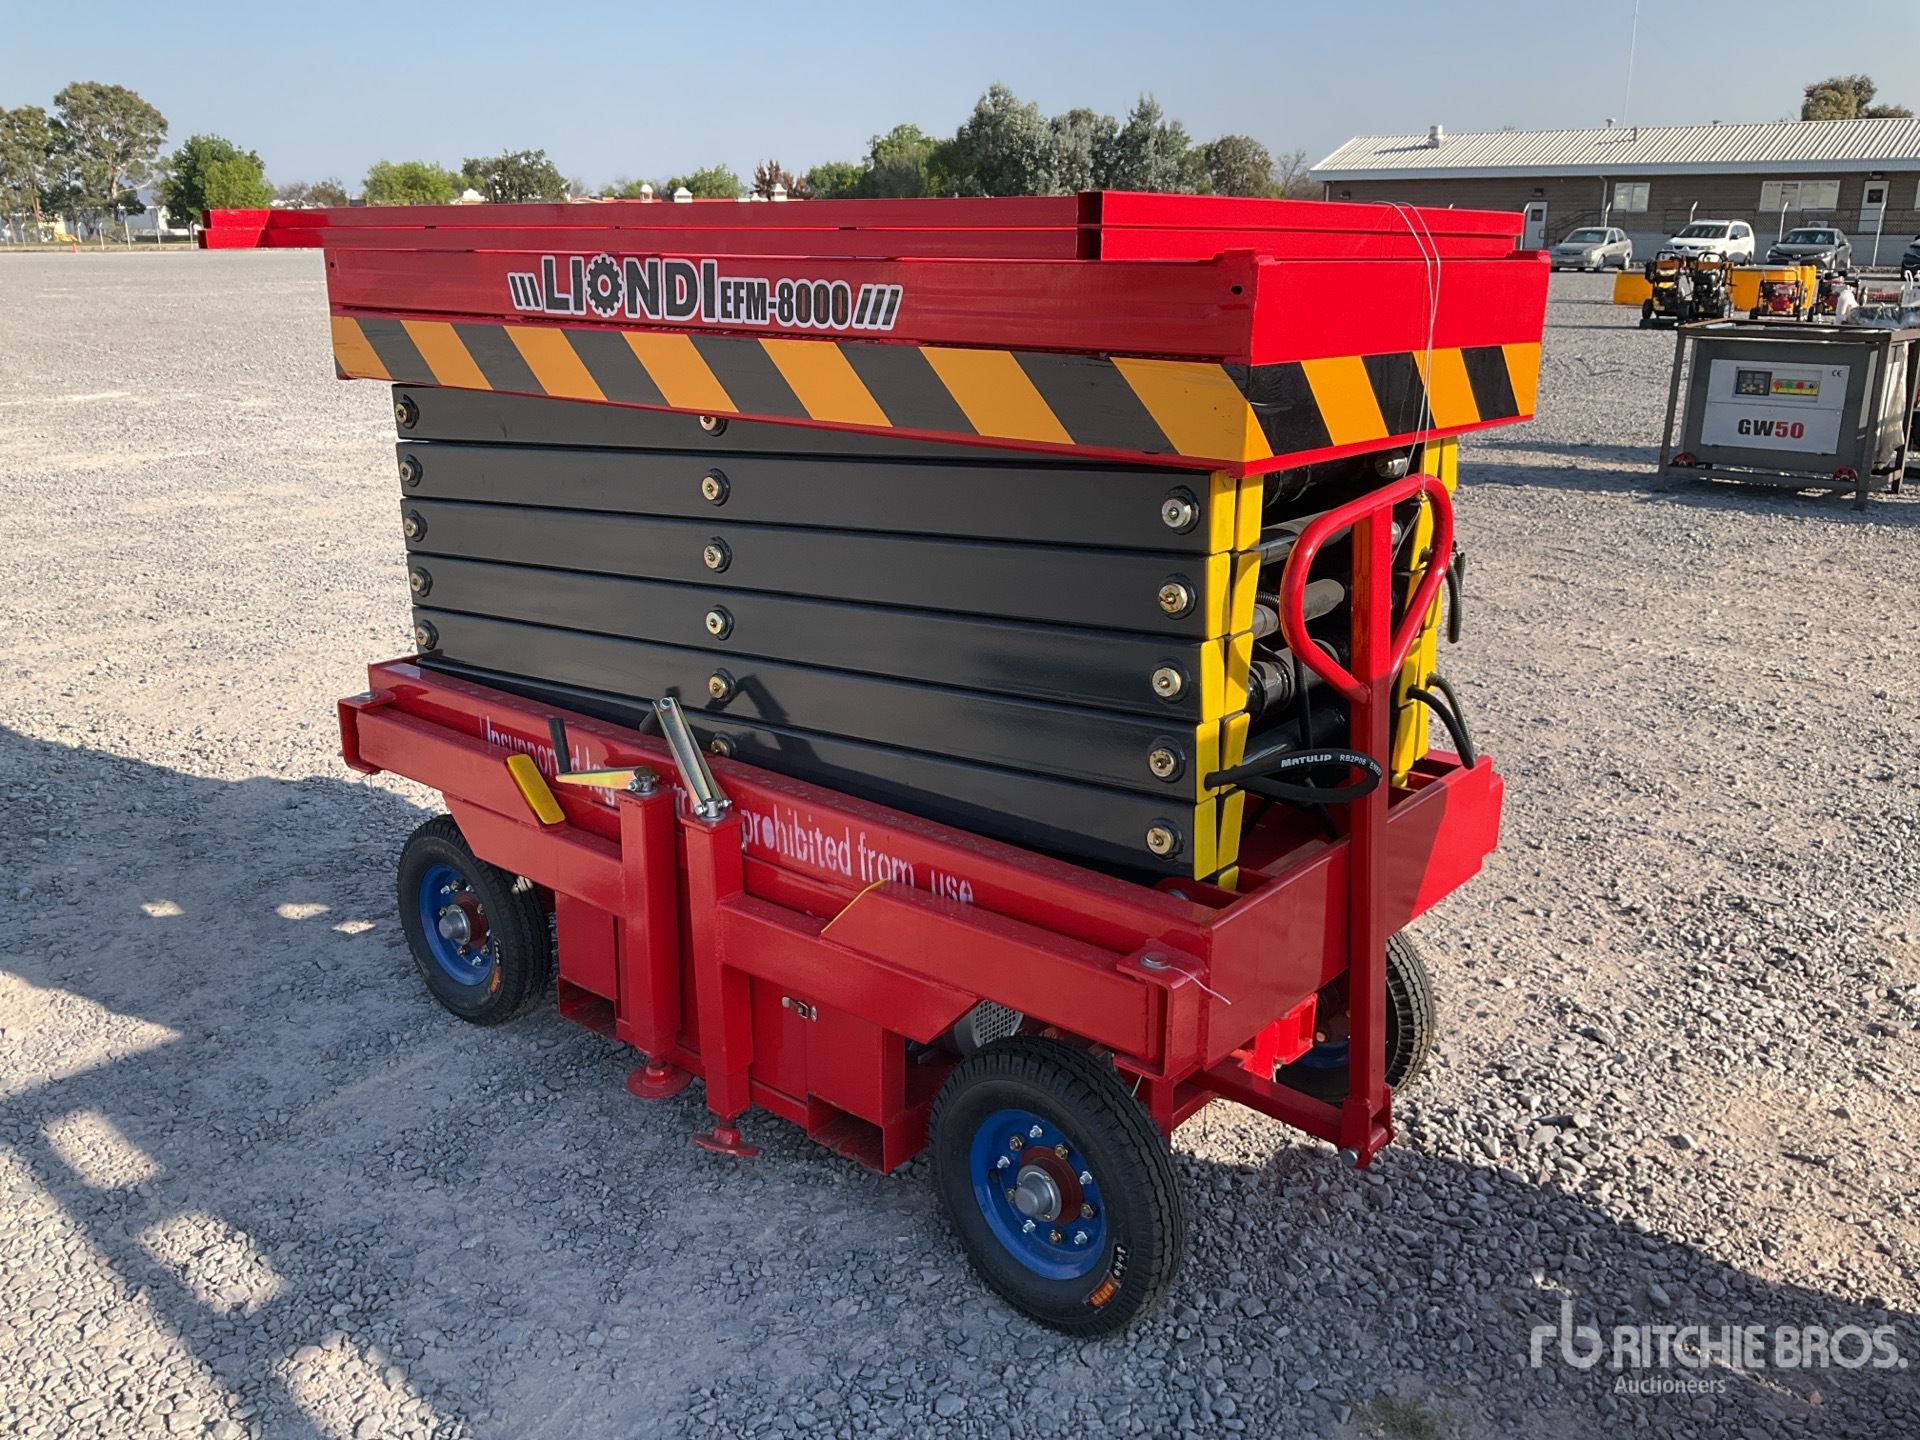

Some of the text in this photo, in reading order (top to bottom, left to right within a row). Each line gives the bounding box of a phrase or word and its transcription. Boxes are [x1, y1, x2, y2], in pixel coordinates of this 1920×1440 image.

[542, 253, 852, 330] LIONDI EFM-8000
[1737, 418, 1805, 439] GW50
[1281, 754, 1332, 768] MATULIP
[740, 804, 852, 876] prohibited
[858, 832, 914, 888] from
[930, 869, 974, 904] use
